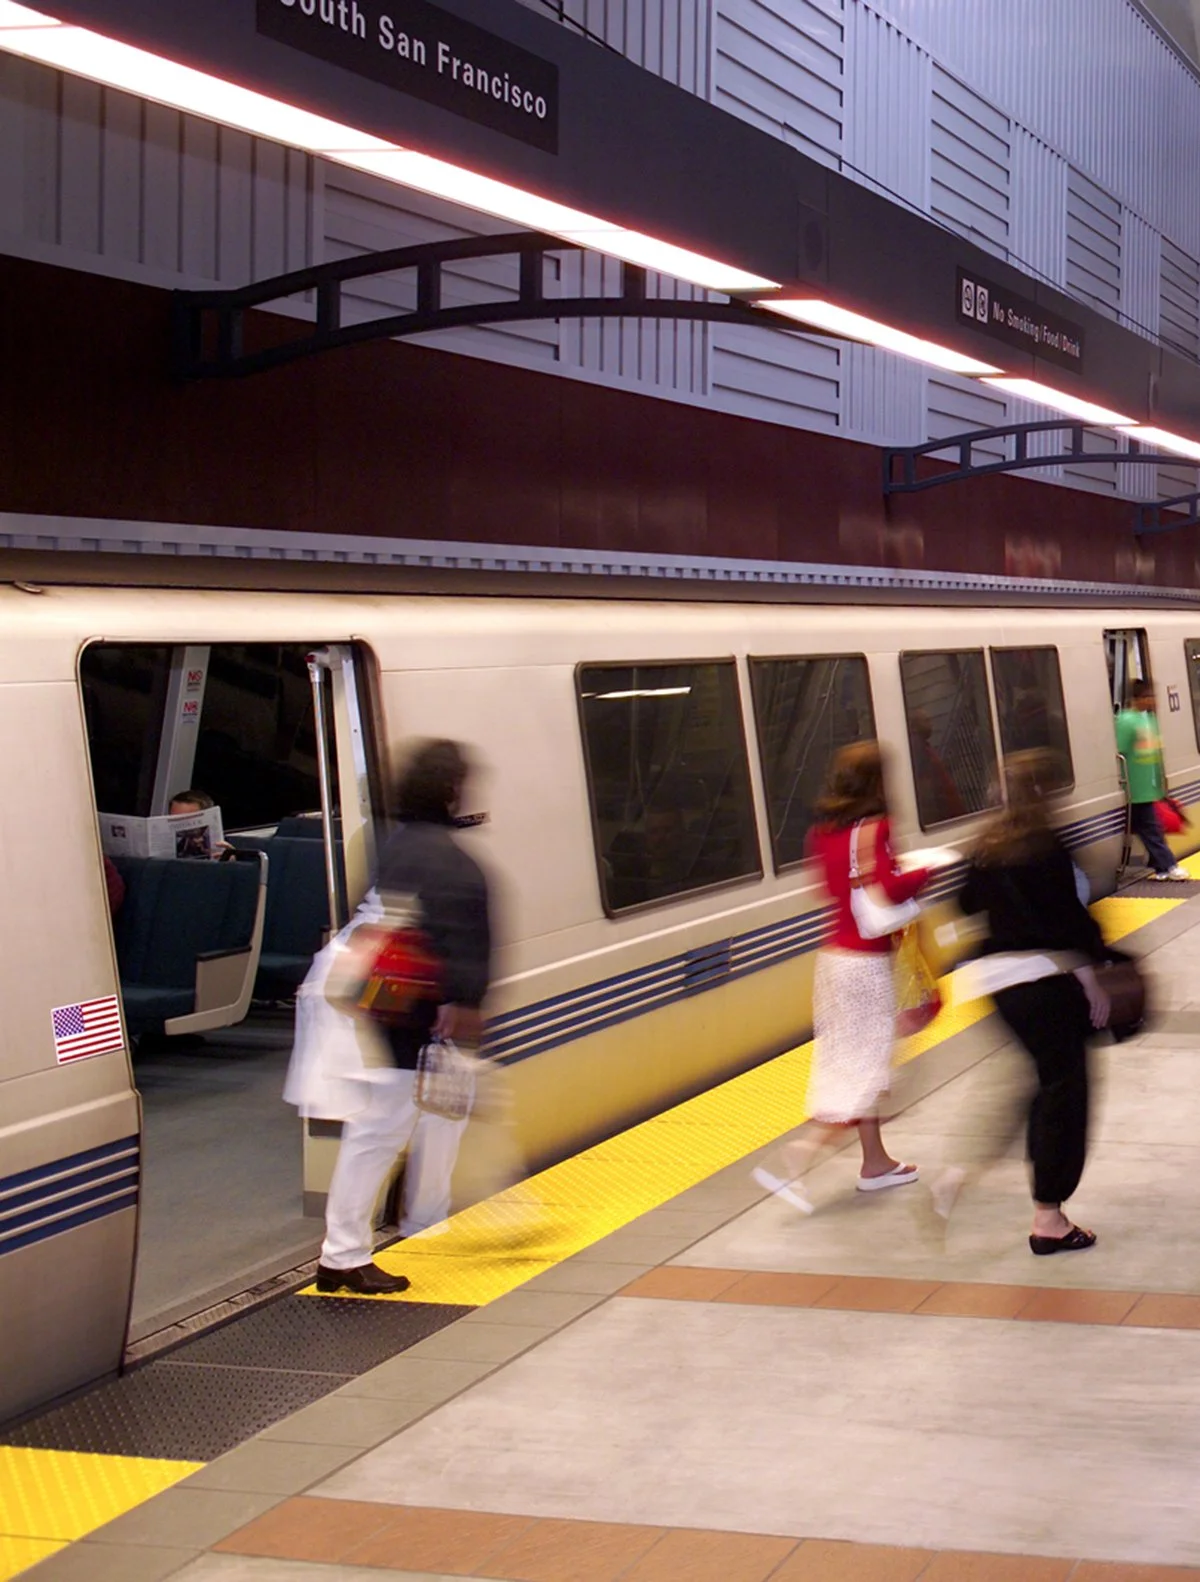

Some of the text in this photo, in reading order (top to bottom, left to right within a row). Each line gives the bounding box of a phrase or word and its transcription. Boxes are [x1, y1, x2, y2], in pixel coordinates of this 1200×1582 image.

[279, 0, 548, 119] outh San Francisco
[992, 301, 1005, 323] No
